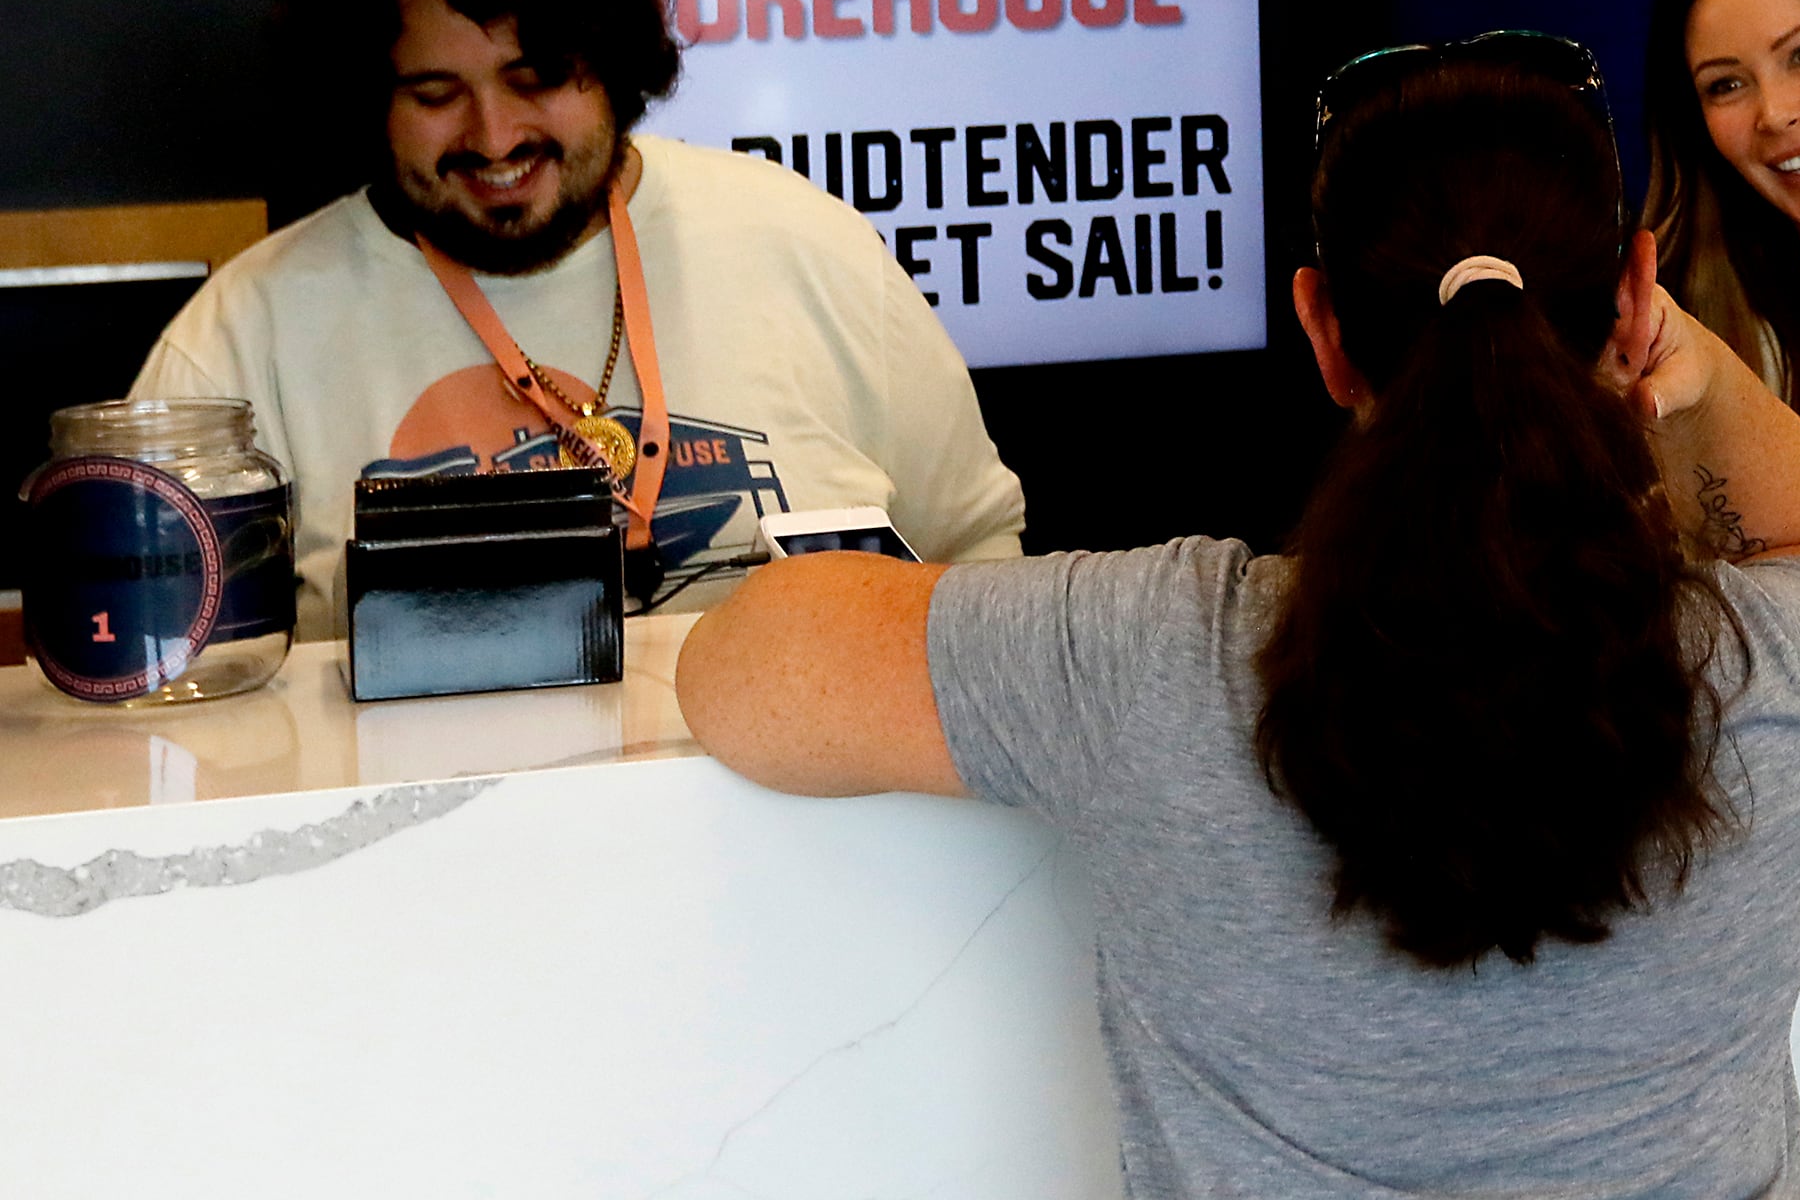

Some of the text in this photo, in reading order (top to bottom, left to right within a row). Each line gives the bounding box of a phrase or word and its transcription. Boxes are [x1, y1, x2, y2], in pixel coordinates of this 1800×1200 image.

[880, 209, 1224, 306] ET SAIL!
[90, 611, 117, 643] 1
